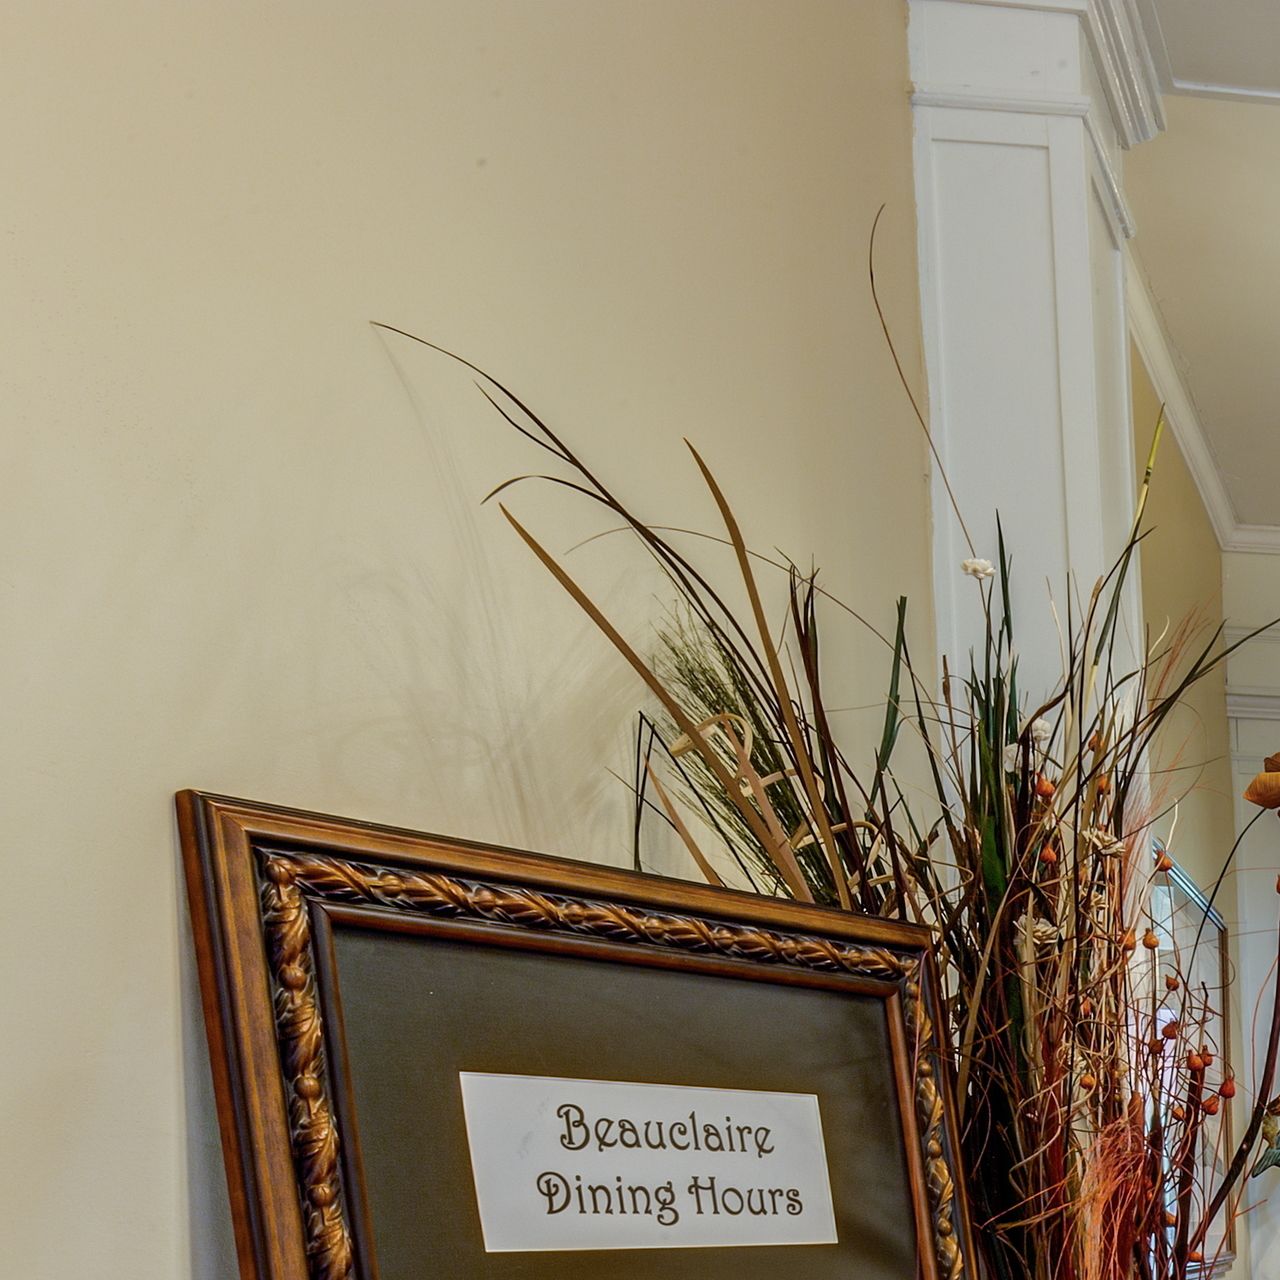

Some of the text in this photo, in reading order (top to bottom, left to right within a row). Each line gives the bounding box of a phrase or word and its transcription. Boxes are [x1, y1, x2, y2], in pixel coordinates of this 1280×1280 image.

[557, 1104, 775, 1158] Beauclaire
[536, 1171, 803, 1226] Dining Hours
